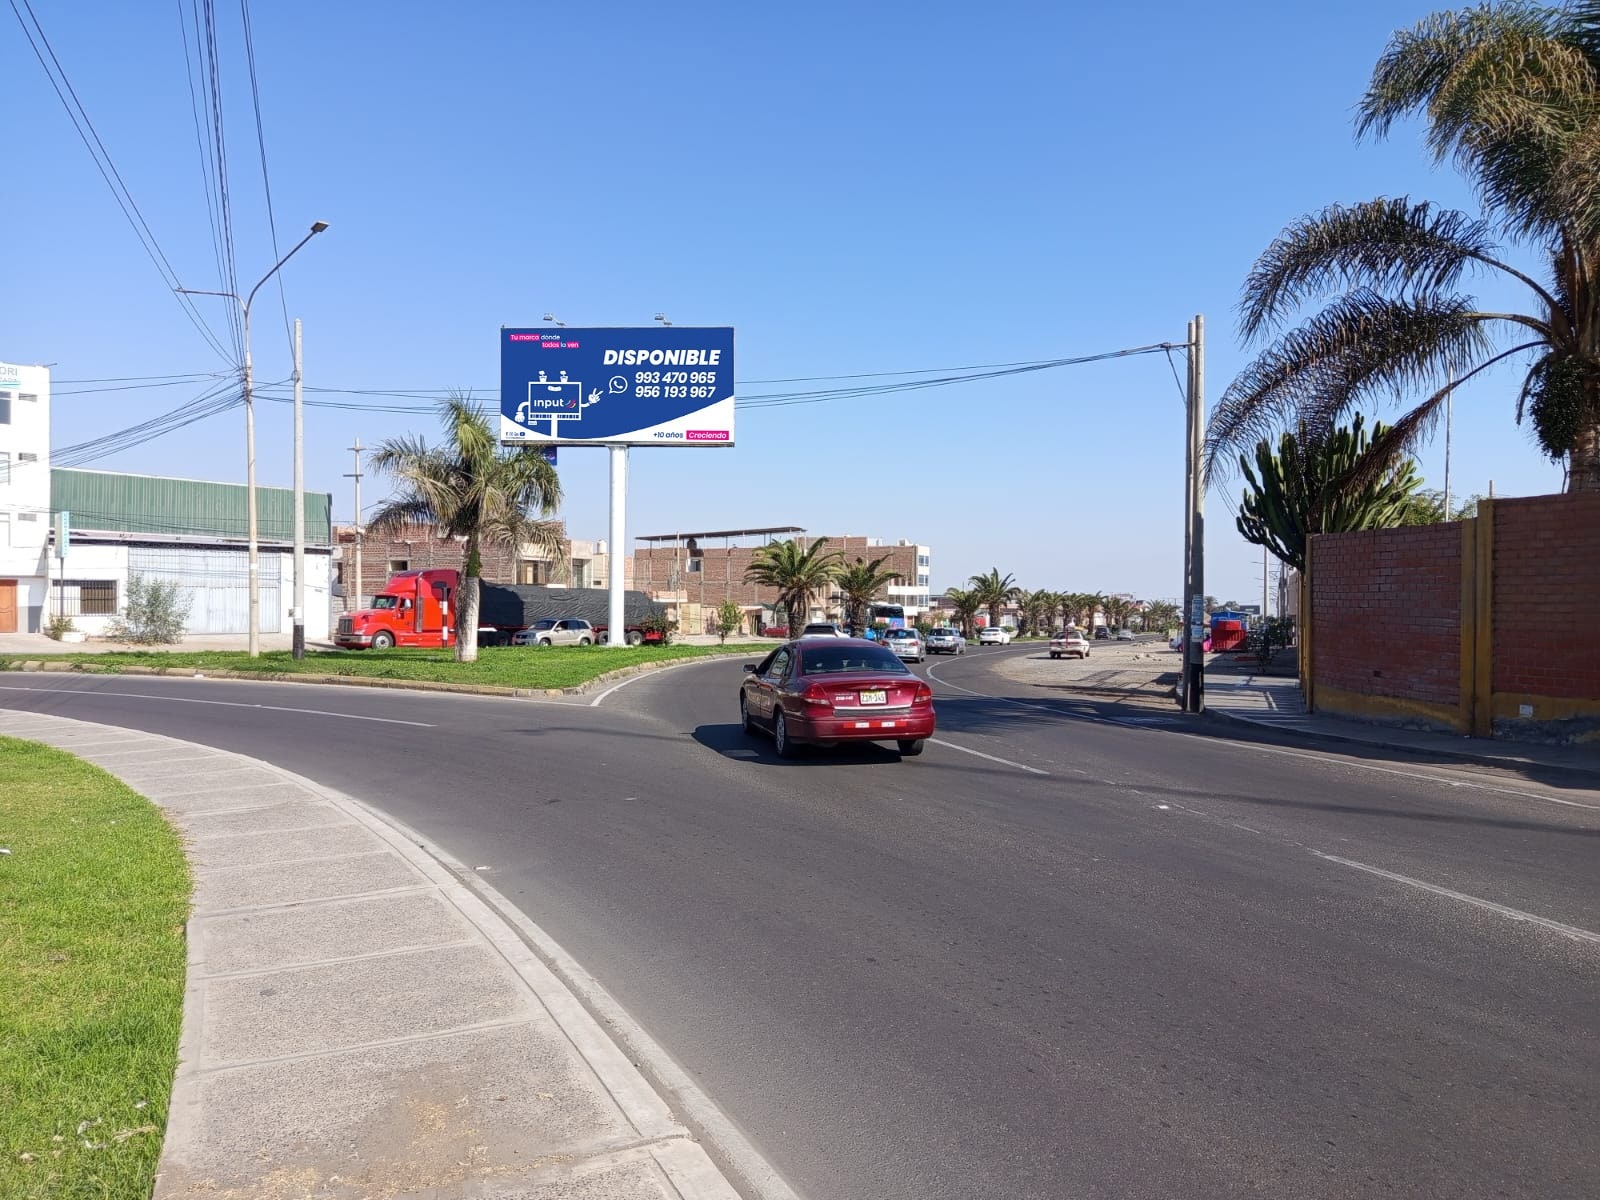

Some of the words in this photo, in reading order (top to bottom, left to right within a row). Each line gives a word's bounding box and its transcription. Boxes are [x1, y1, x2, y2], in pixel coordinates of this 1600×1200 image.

[603, 349, 721, 366] DISPONIBLE
[635, 371, 661, 384] 993
[662, 371, 688, 384] 470
[690, 371, 716, 384] 965
[635, 386, 661, 398] 956
[663, 386, 688, 398] 193
[690, 386, 716, 398] 967
[533, 398, 564, 409] input
[688, 431, 727, 439] Creciendo
